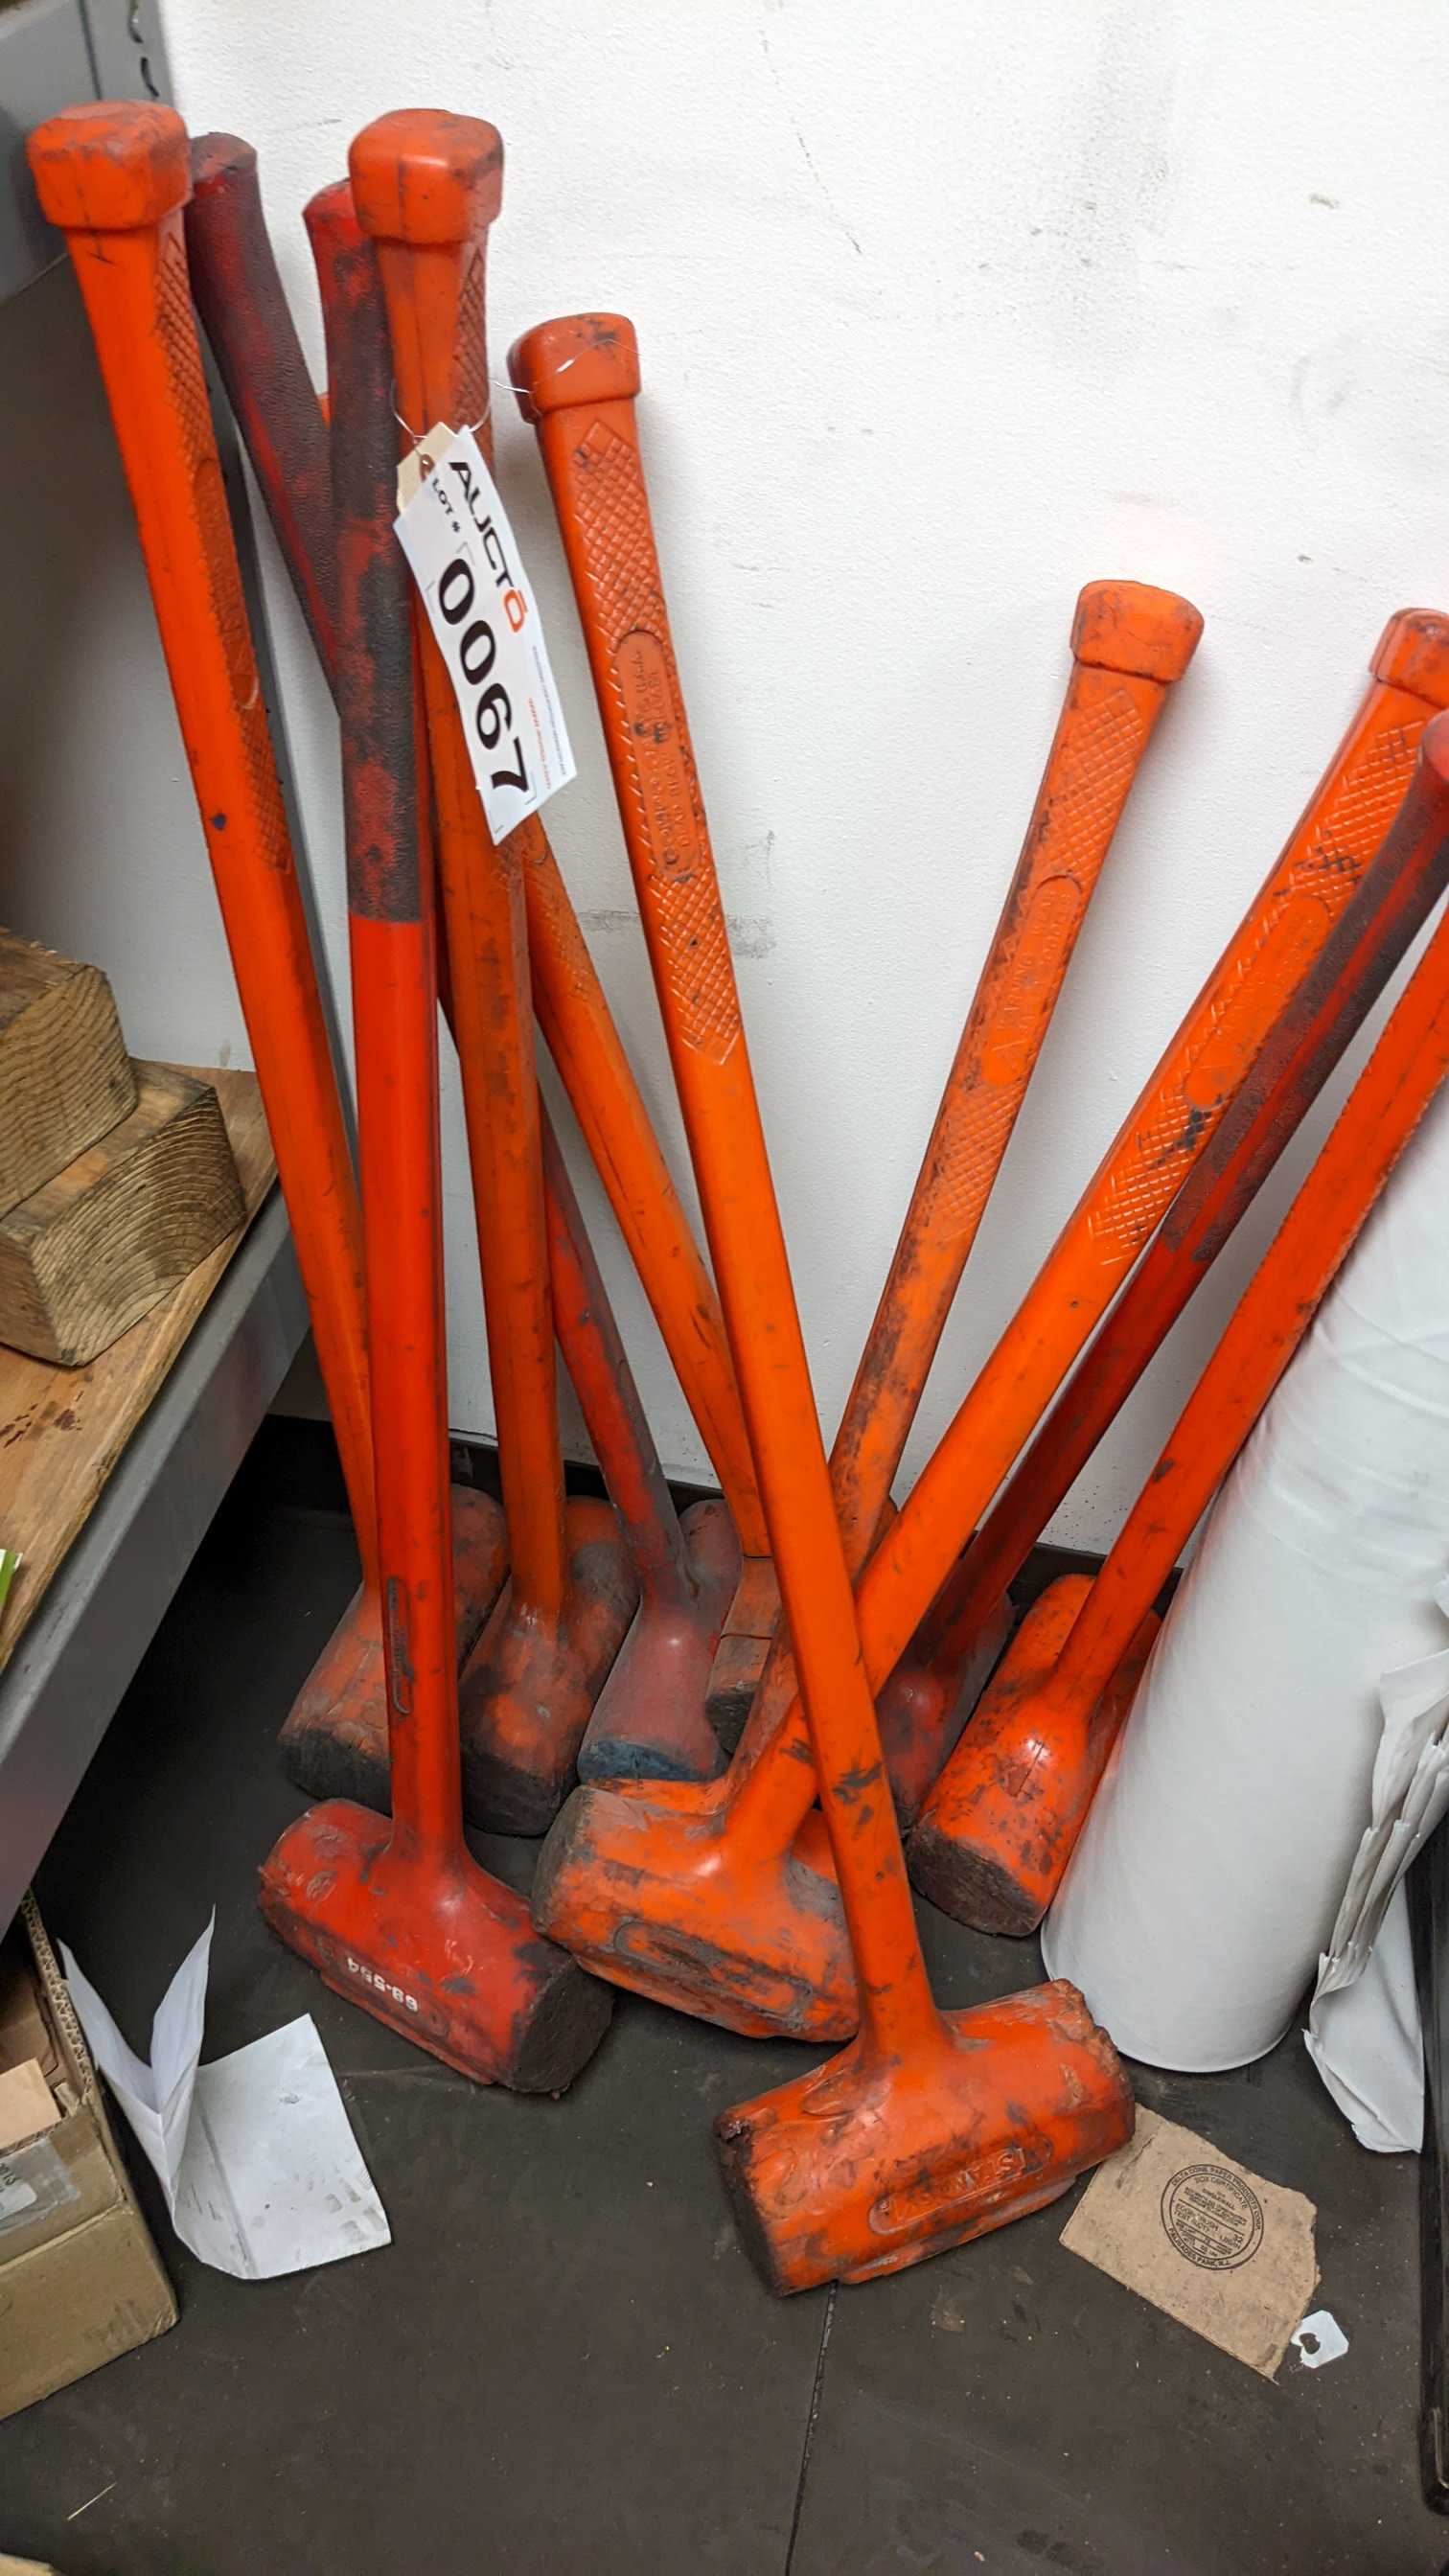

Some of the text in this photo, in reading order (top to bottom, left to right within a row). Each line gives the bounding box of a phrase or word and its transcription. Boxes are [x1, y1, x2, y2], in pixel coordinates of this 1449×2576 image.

[431, 478, 462, 534] LOT #
[438, 558, 530, 794] 0067
